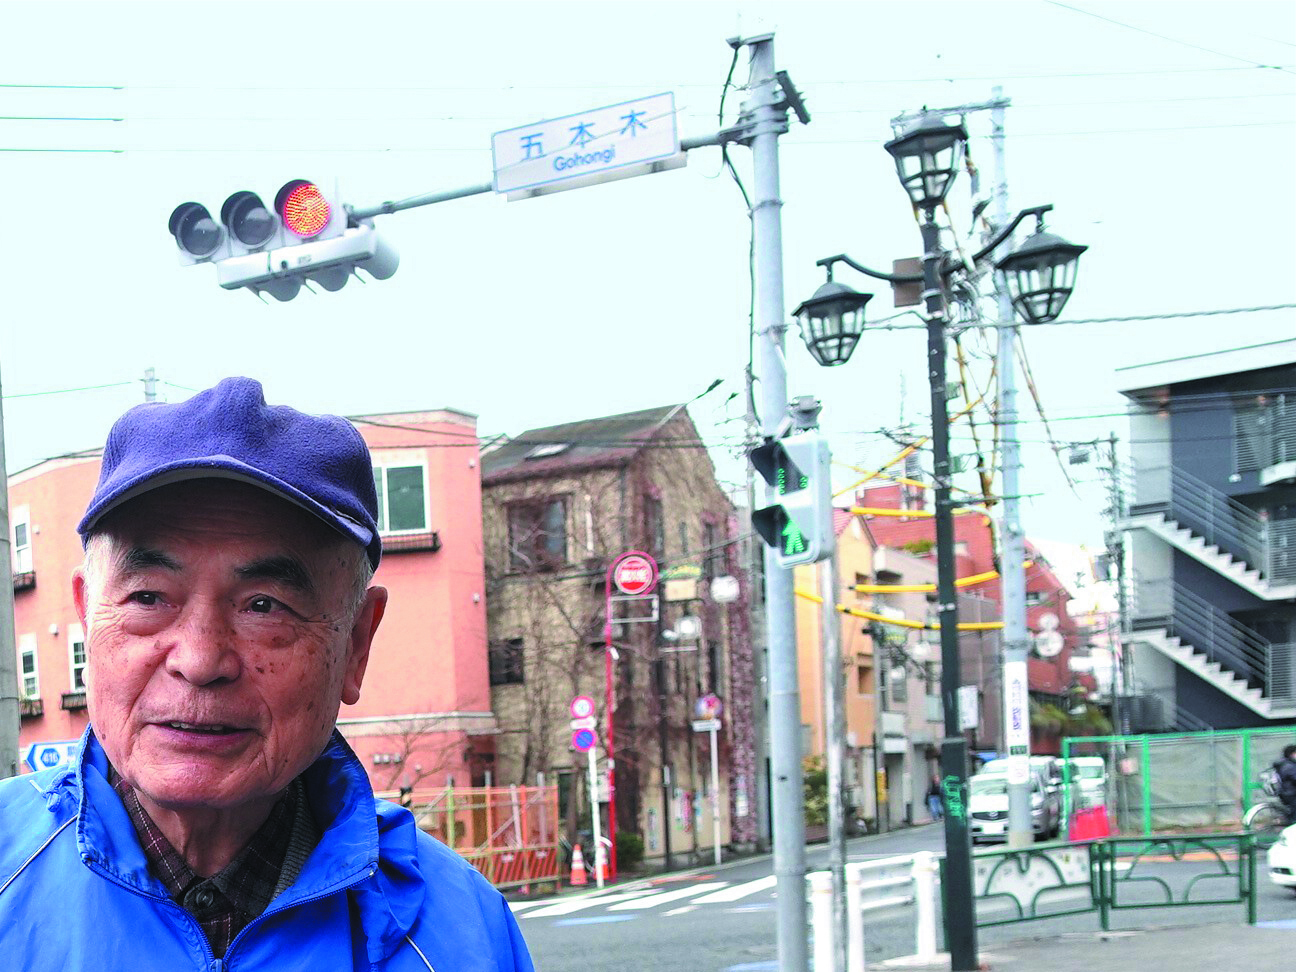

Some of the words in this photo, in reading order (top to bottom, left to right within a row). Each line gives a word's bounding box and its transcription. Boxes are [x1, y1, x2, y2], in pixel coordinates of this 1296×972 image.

[519, 109, 647, 163] 五本木
[554, 145, 616, 171] Gohongi
